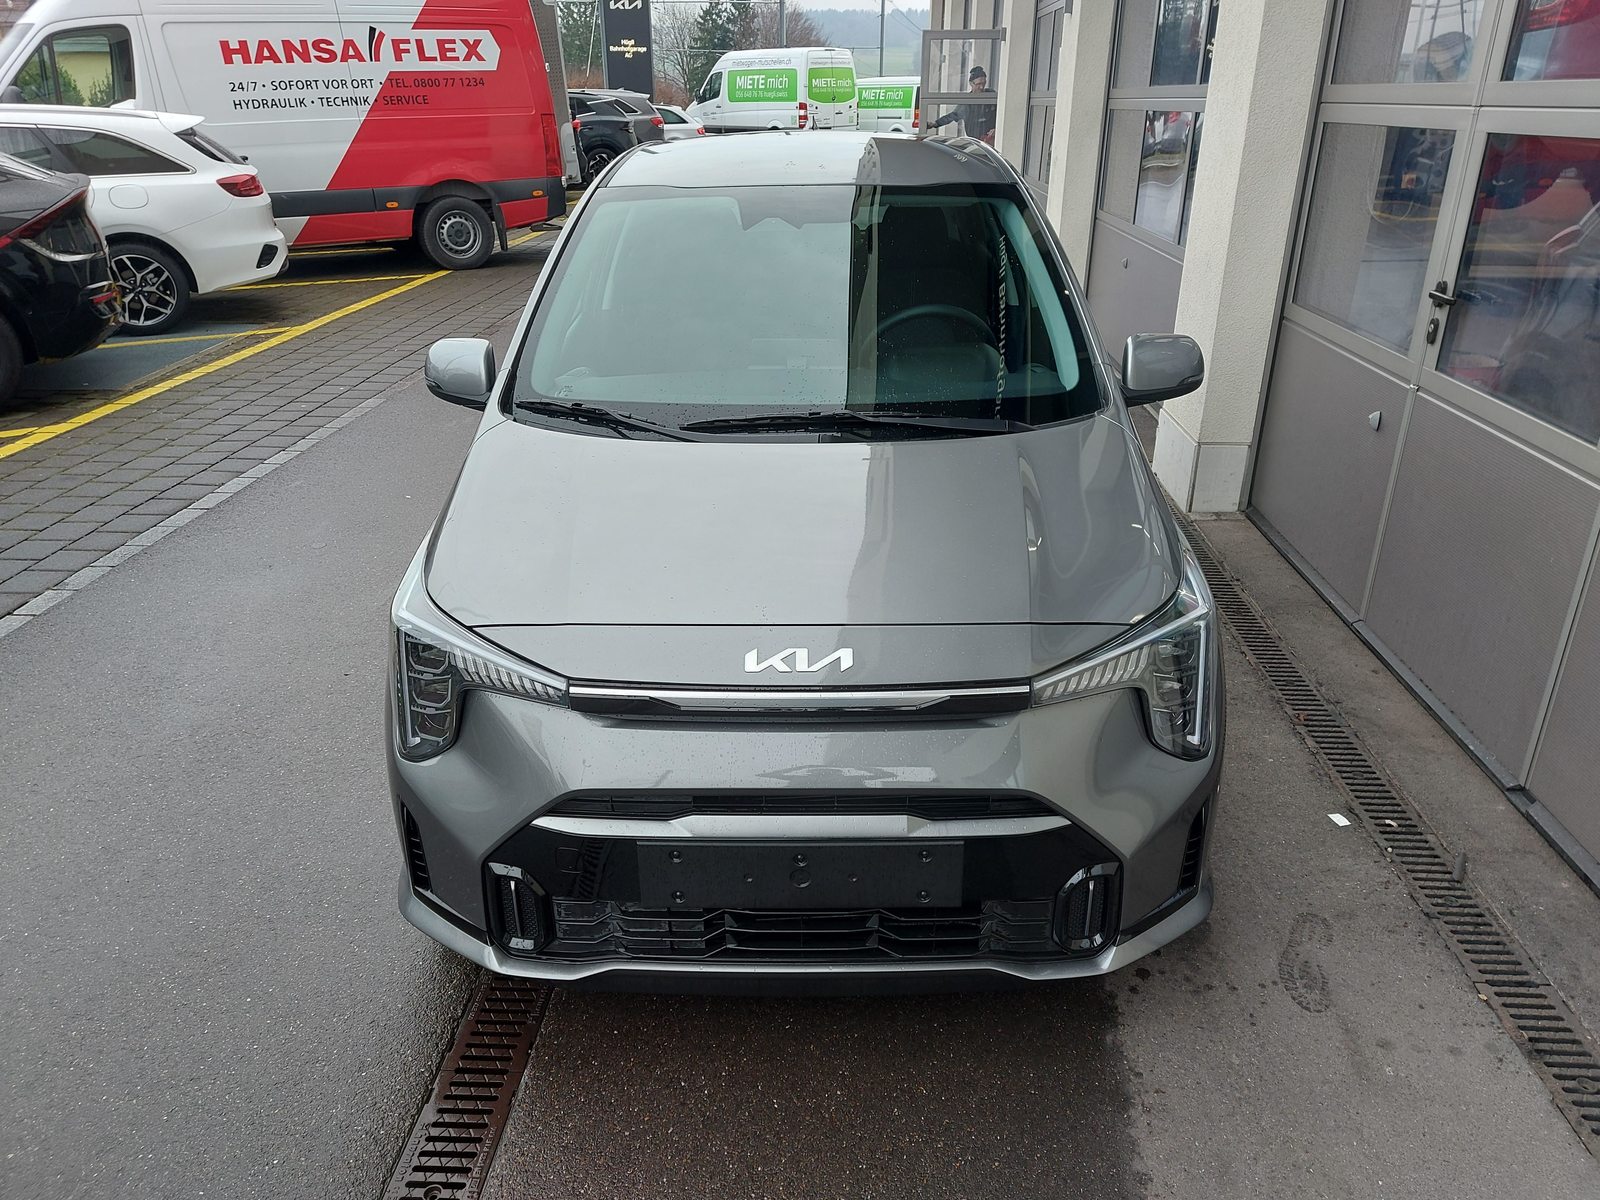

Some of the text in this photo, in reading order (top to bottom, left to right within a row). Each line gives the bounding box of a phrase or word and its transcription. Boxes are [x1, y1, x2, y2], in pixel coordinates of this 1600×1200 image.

[219, 37, 487, 66] HANSA FLEX
[229, 80, 258, 93] 24/7
[269, 79, 320, 92] SOFORT
[321, 78, 348, 91] VOR
[350, 77, 375, 90] ORT
[442, 77, 456, 88] 77
[458, 76, 486, 88] 1234
[736, 73, 789, 89] MIETE mich
[812, 78, 853, 88] MIETE mich
[233, 94, 430, 110] HYDRAULIK TECHNIK SERVICE
[861, 89, 886, 100] MIETE
[885, 88, 904, 100] mich
[744, 647, 854, 673] KIA
